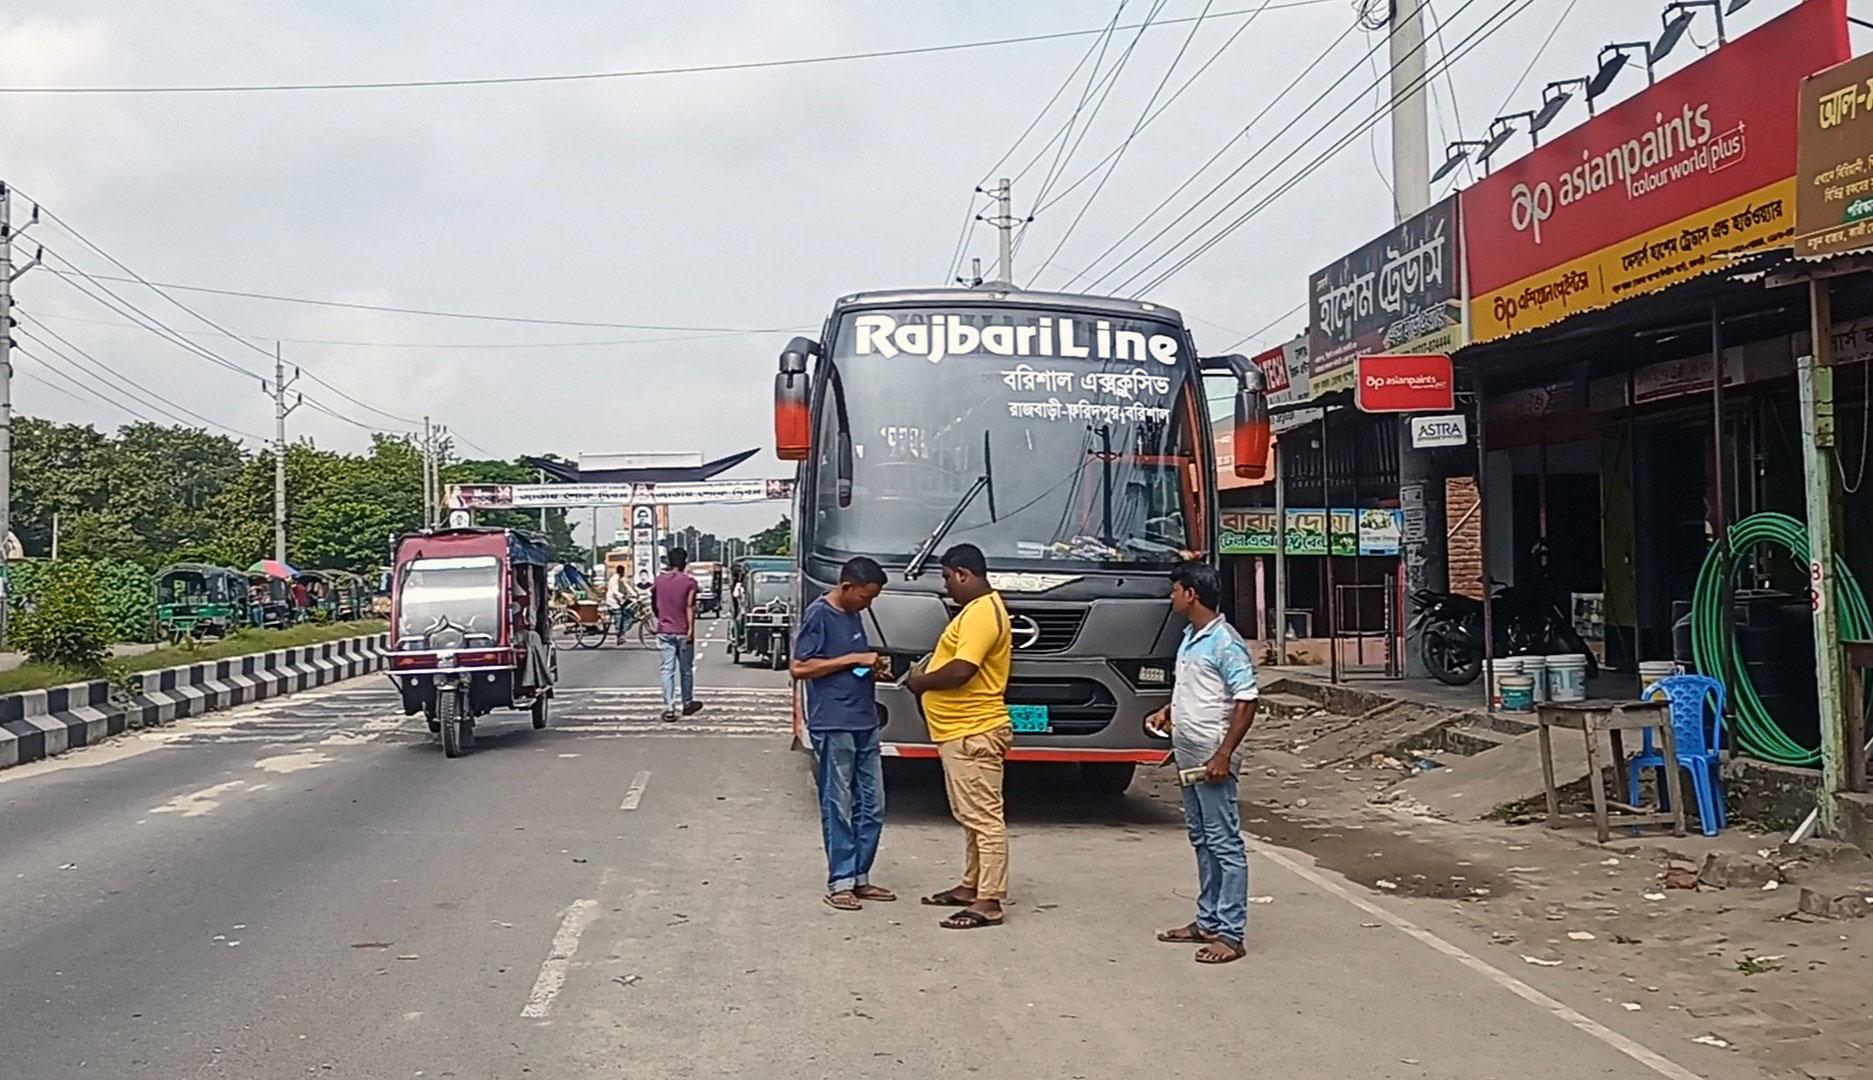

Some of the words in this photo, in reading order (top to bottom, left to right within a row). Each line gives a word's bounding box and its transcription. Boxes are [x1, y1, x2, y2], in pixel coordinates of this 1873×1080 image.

[1559, 102, 1712, 200] asianpaints
[1631, 166, 1669, 198] colour
[1669, 145, 1708, 182] world
[1318, 271, 1375, 337] হাশেম
[1379, 218, 1446, 312] ট্রেডার্স
[855, 314, 1053, 364] Rajbari
[1059, 318, 1179, 365] Line
[1001, 364, 1074, 392] বরিশাল
[1260, 353, 1287, 391] TECH
[1385, 373, 1437, 389] asianpaints
[1419, 422, 1461, 436] ASTRA
